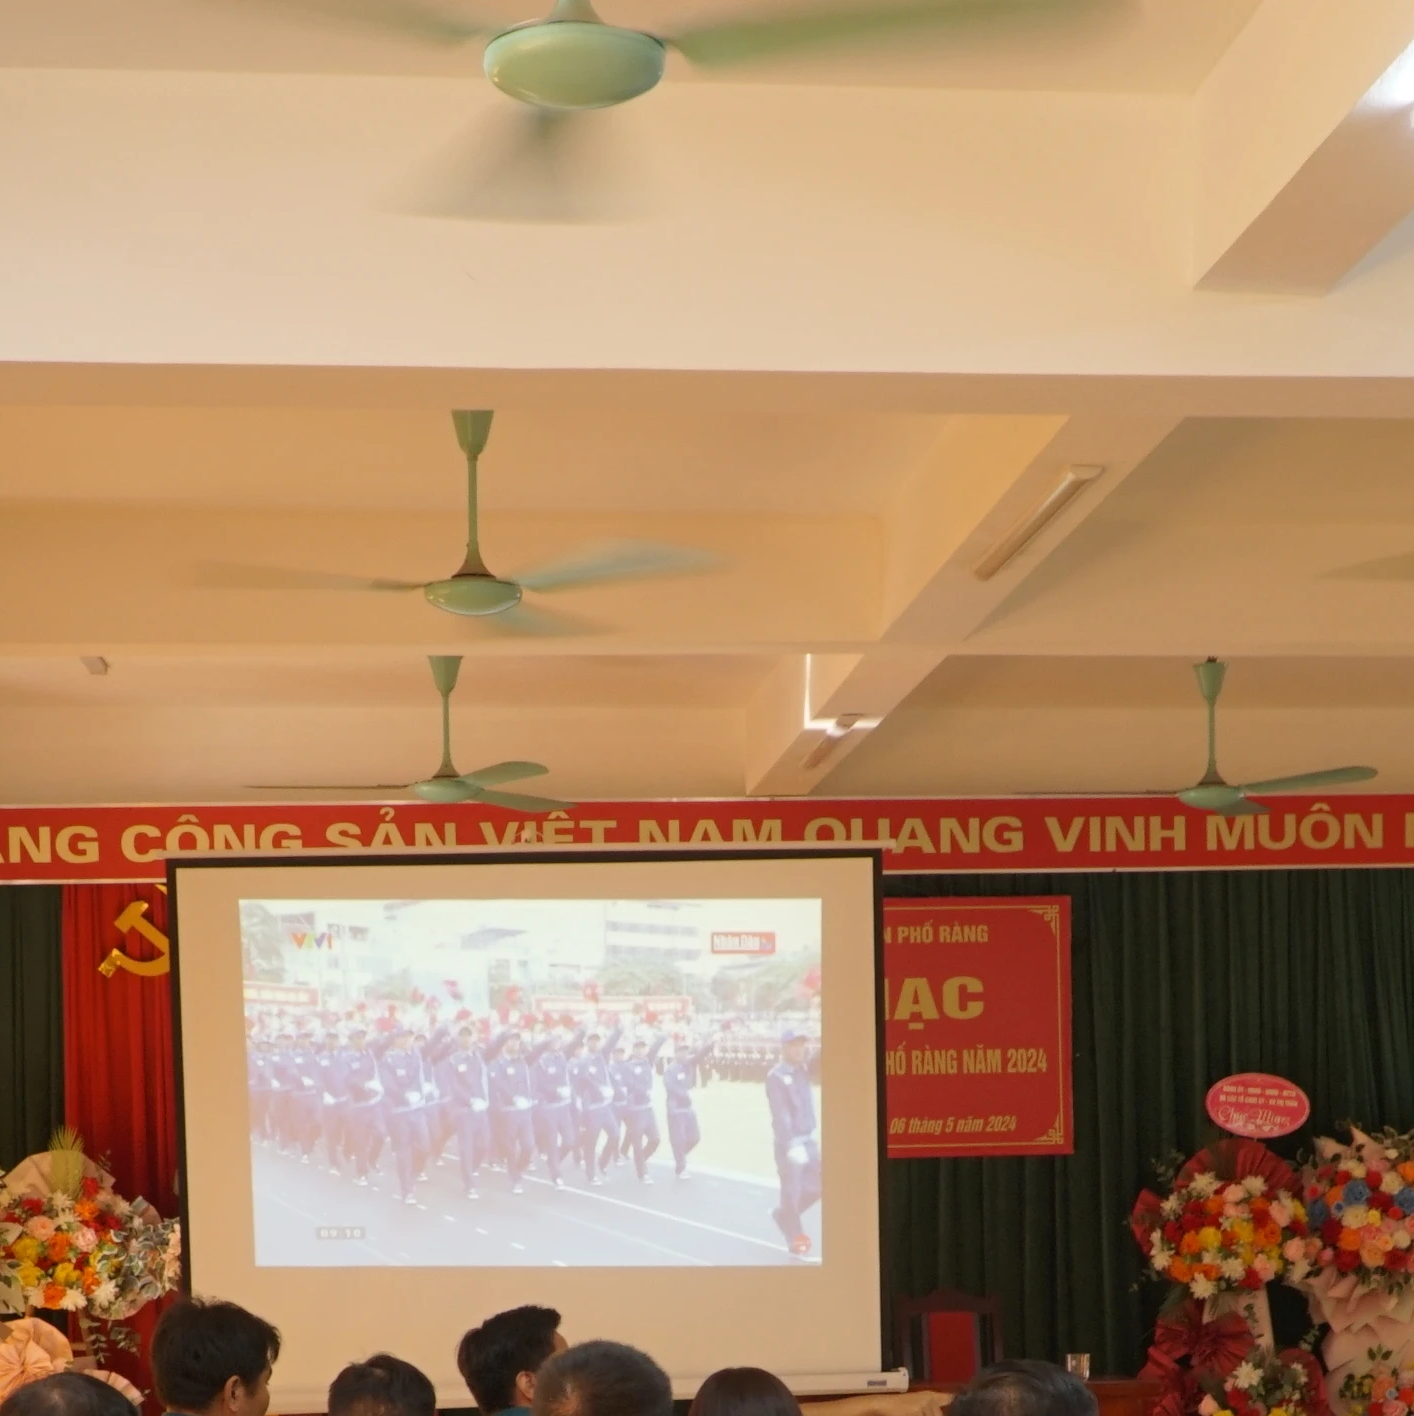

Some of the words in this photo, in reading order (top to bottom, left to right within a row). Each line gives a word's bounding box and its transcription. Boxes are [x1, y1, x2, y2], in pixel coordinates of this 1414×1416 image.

[120, 814, 303, 863] CÔNG
[325, 807, 457, 849] SẢN
[638, 818, 783, 844] NAM
[1044, 815, 1187, 852] VINH
[1205, 803, 1384, 850] MUÔN
[897, 919, 933, 944] PHỐ
[939, 921, 989, 943] RÀNG
[884, 975, 985, 1031] ẠC
[886, 1041, 906, 1076] HỐ
[911, 1045, 958, 1075] RÀNG
[962, 1043, 1002, 1074] NĂM
[1007, 1048, 1048, 1073] 2024
[956, 1115, 984, 1133] năm
[985, 1114, 1017, 1132] 2024
